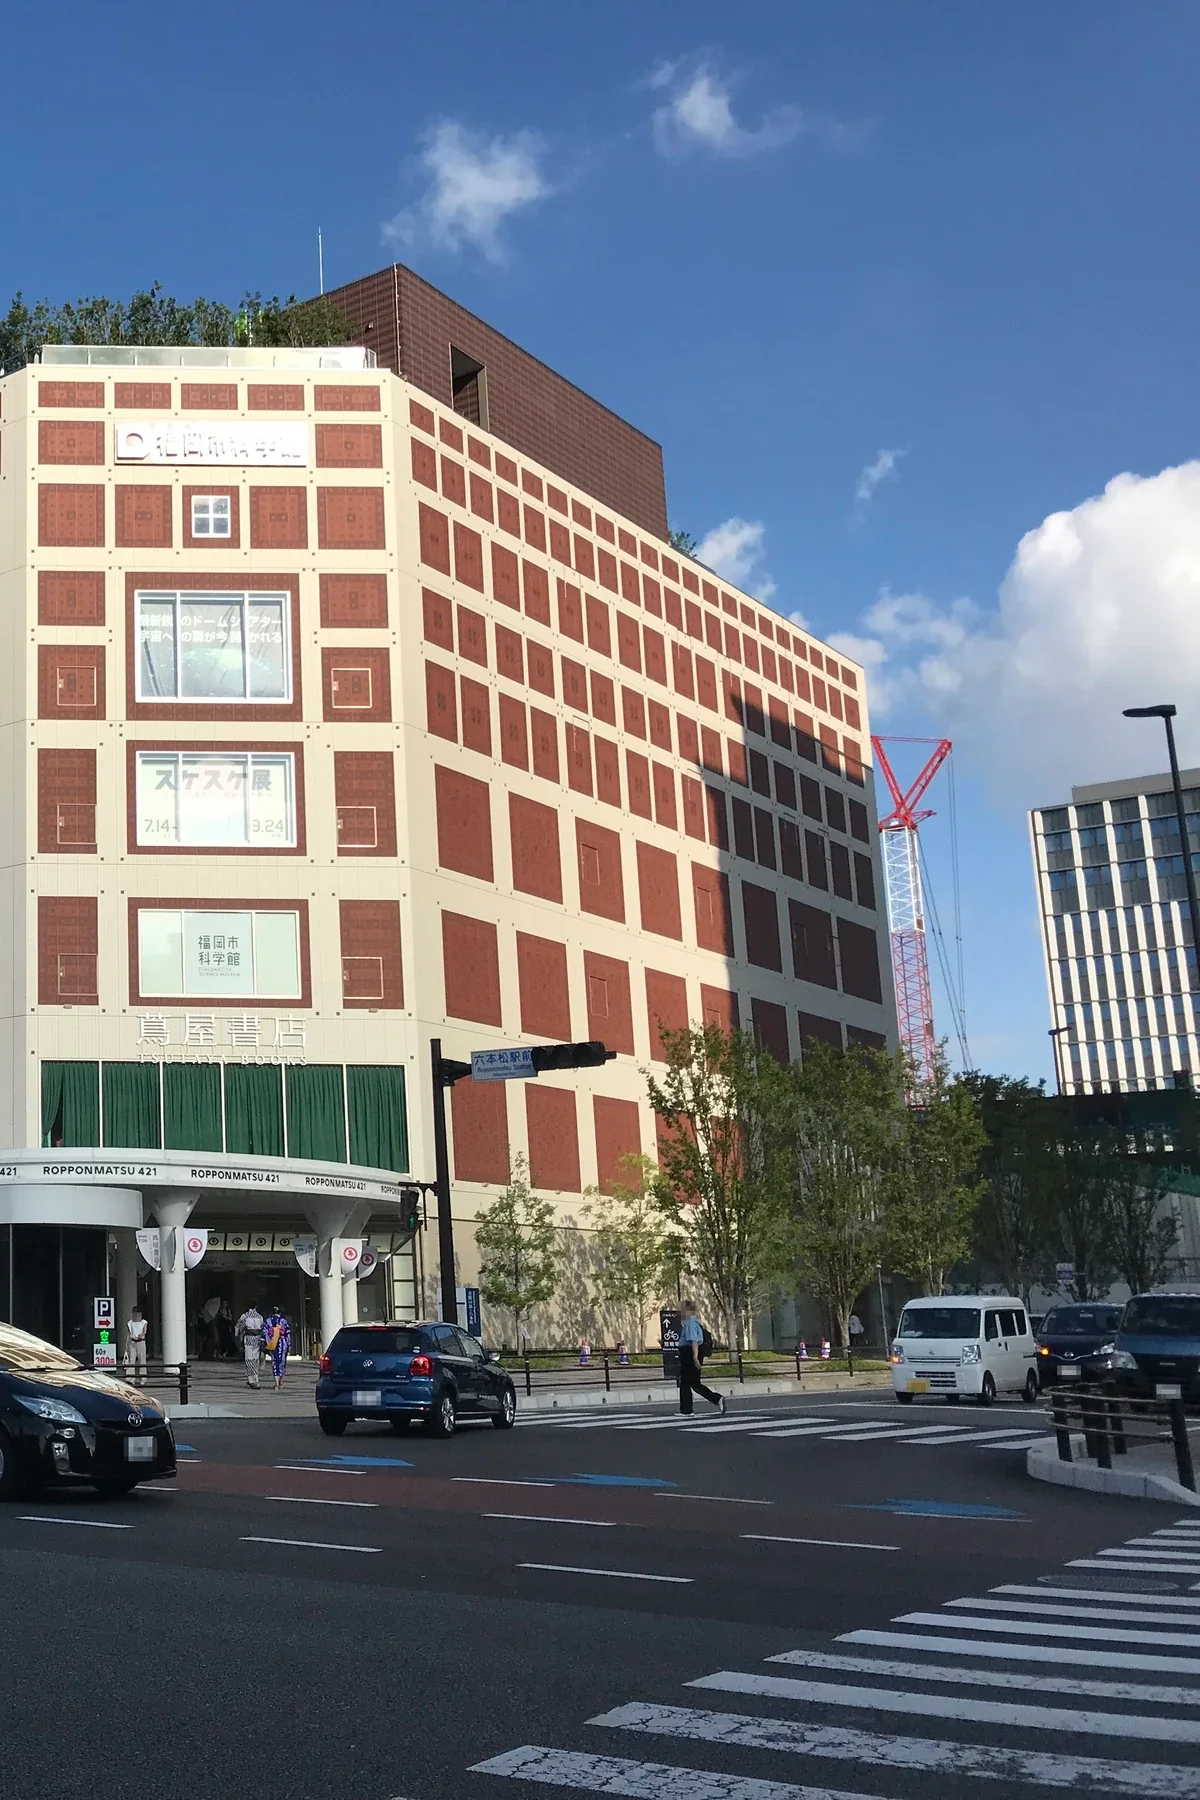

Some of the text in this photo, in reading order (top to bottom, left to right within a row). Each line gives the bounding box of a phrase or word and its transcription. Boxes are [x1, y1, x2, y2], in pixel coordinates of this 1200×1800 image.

[154, 769, 272, 791] スケスケ展
[252, 819, 284, 833] 9.24
[198, 935, 238, 950] 福岡市
[198, 951, 240, 966] 科学館
[138, 1053, 307, 1066] TSUTAYA BOOKS
[474, 1050, 532, 1066] 六本松駅前
[0, 1167, 18, 1176] 421
[43, 1166, 157, 1176] ROPPONMATSU 421
[191, 1169, 280, 1183] ROPPONMATSU 421
[305, 1176, 367, 1191] ROPPONMATSU 421
[100, 1301, 109, 1316] P
[100, 1330, 109, 1345] 空
